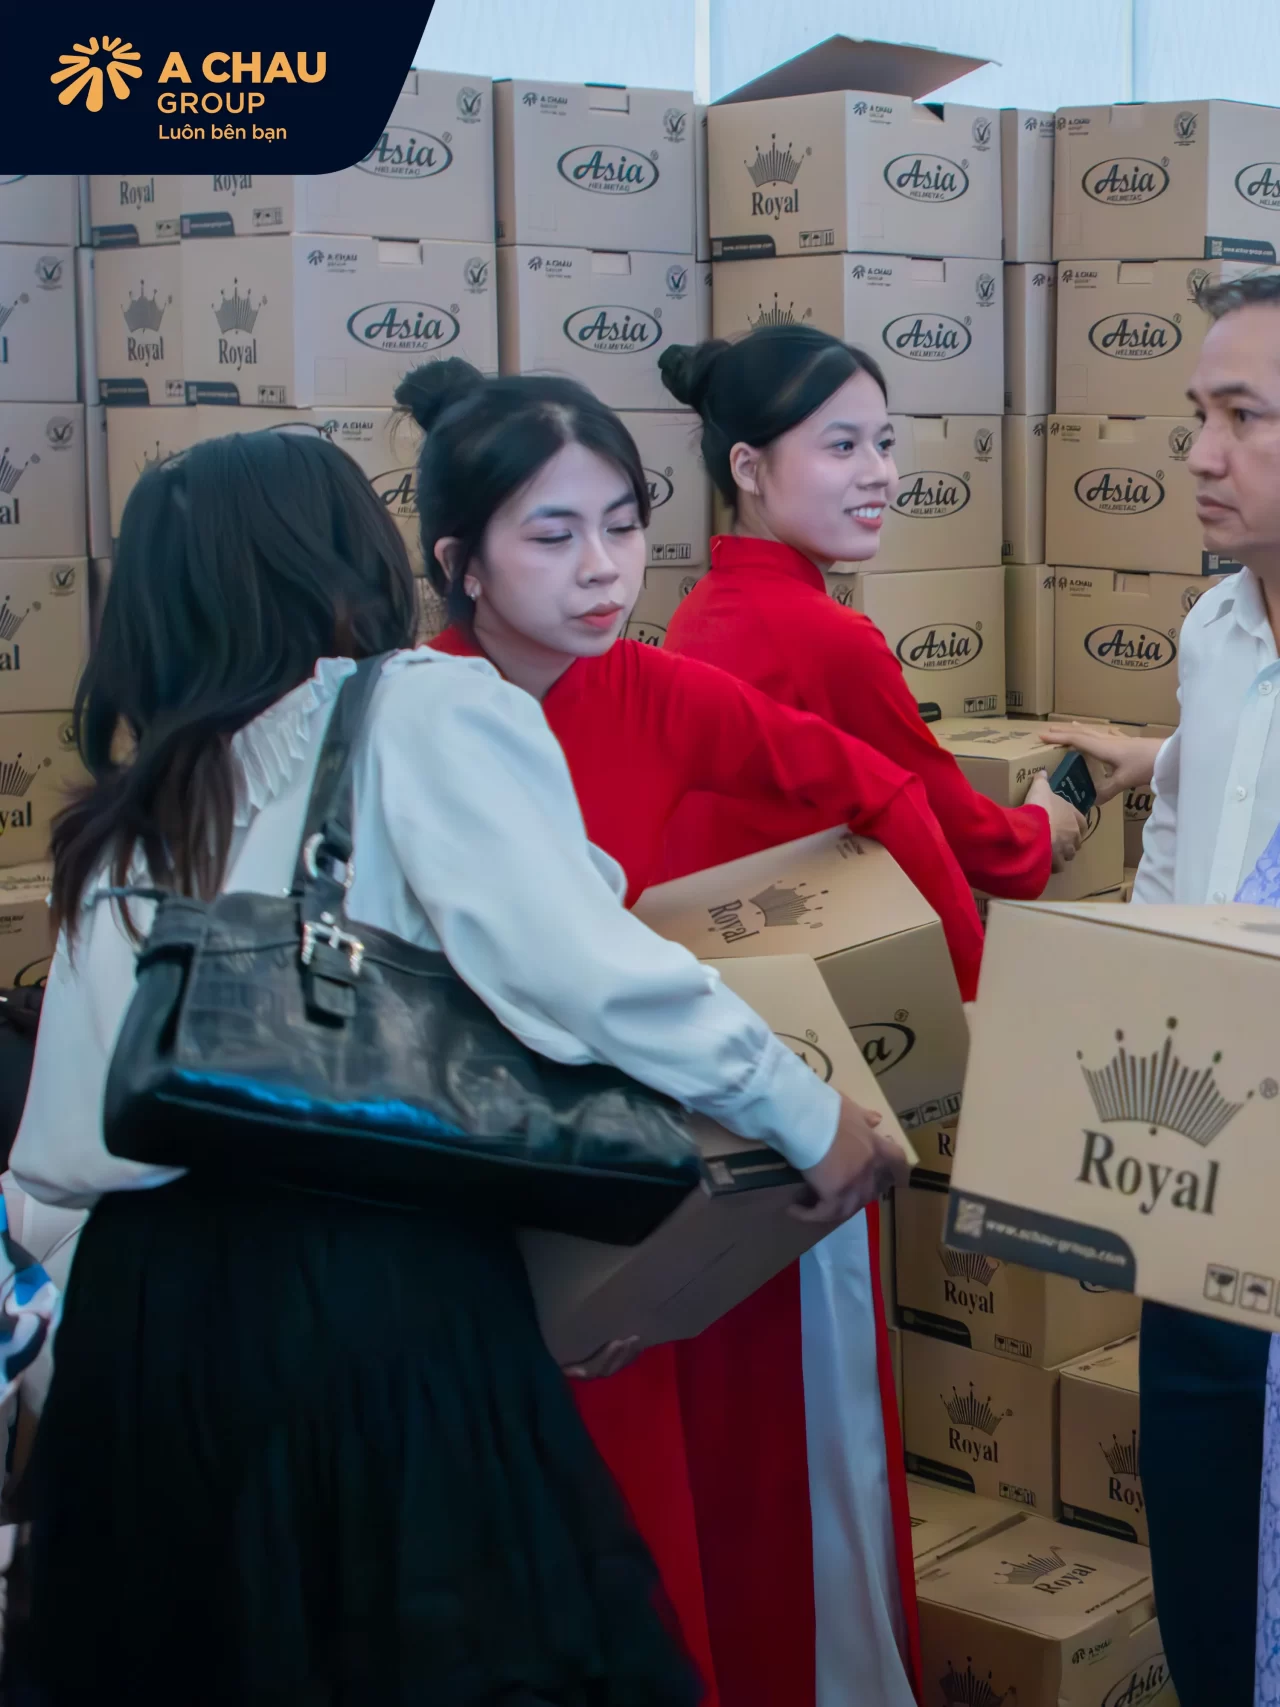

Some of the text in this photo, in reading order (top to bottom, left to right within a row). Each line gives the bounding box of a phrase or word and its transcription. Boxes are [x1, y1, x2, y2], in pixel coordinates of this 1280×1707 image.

[573, 150, 645, 184] Asia
[896, 159, 957, 191] Asia
[1094, 164, 1157, 194] Asia
[120, 178, 154, 210] Royal
[751, 188, 799, 221] Royal
[364, 308, 444, 339] Asia
[578, 311, 649, 342] Asia
[896, 319, 960, 349] Asia
[1102, 319, 1168, 348] Asia
[127, 336, 164, 367] Royal
[219, 338, 257, 372] Royal
[896, 477, 960, 507] Asia
[1086, 474, 1151, 503] Asia
[910, 630, 971, 661] Asia
[1098, 629, 1162, 661] Asia
[707, 899, 760, 944] Royal
[1075, 1129, 1221, 1216] Royal
[943, 1280, 994, 1315] Royal
[949, 1427, 999, 1464] Royal
[1108, 1476, 1145, 1514] Roy
[1032, 1563, 1098, 1595] Royal
